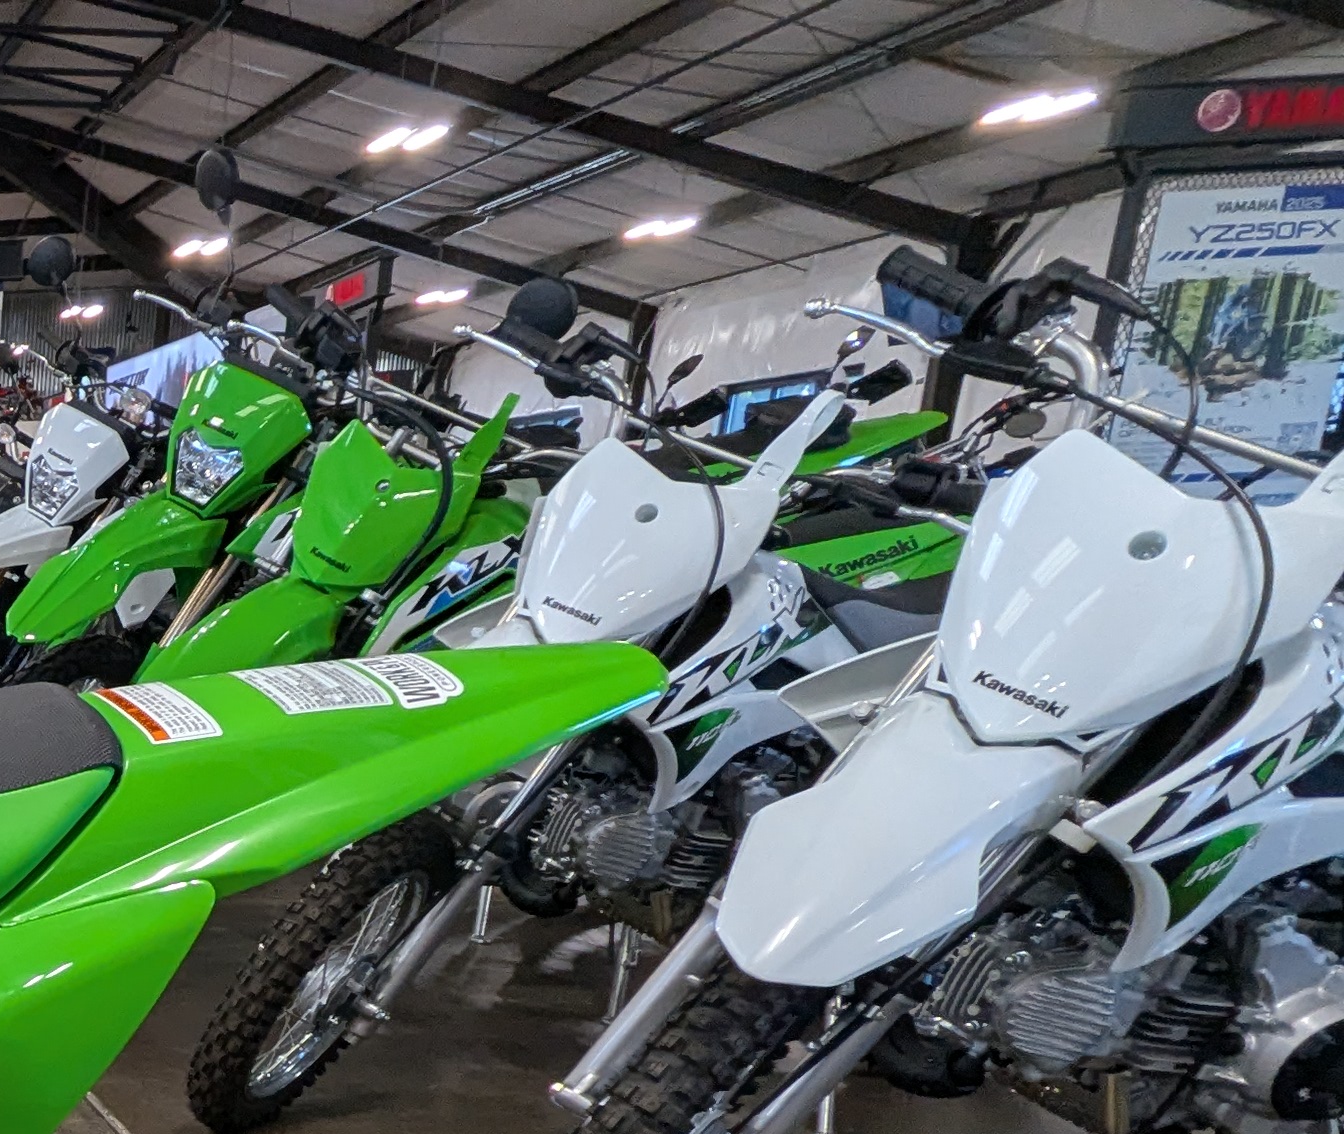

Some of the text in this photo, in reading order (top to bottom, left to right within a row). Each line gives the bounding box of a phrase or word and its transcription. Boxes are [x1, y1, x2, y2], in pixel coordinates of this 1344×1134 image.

[1216, 196, 1328, 214] YAMAHA 2025
[1189, 219, 1342, 245] YZ250FX
[310, 547, 352, 574] Kawasaki
[817, 535, 919, 575] Kawasaki
[542, 595, 603, 627] Kawasaki
[972, 670, 1070, 719] Kawasaki
